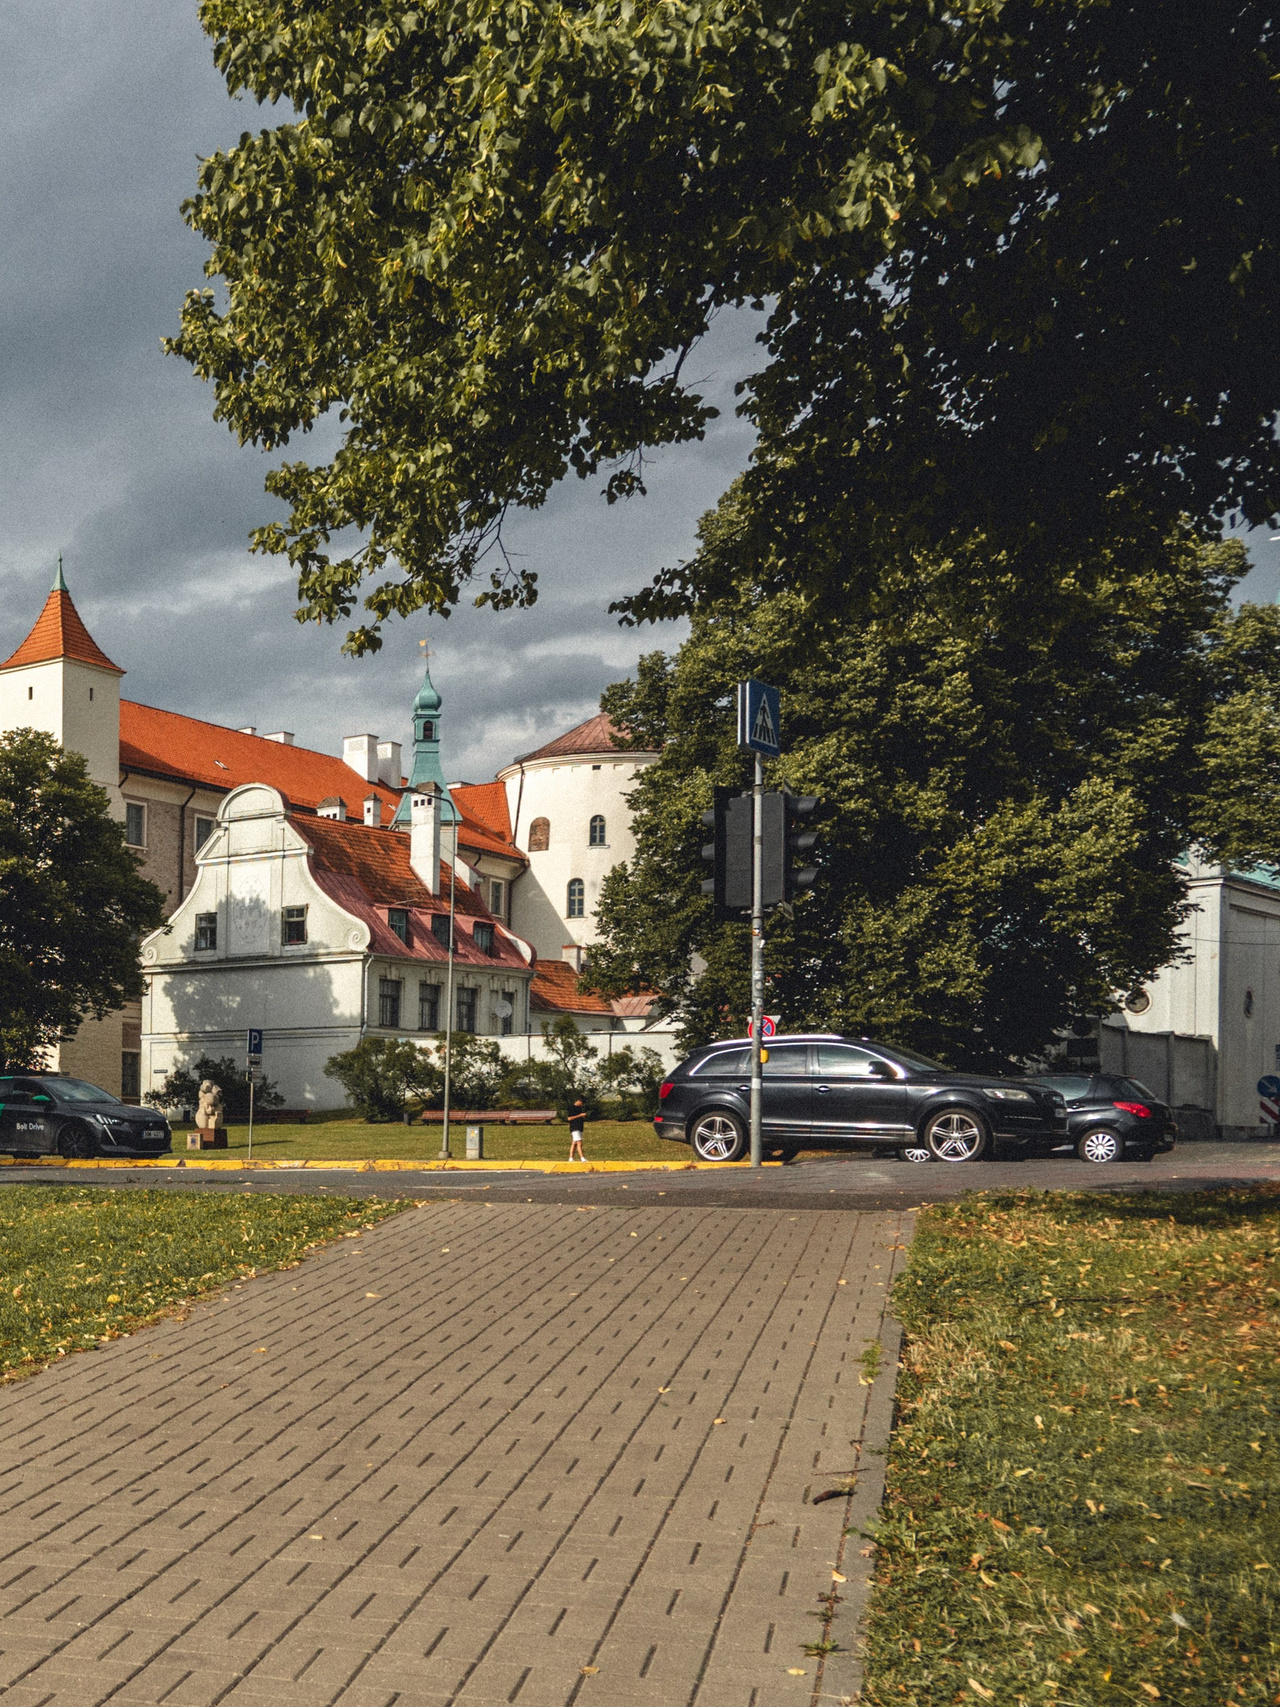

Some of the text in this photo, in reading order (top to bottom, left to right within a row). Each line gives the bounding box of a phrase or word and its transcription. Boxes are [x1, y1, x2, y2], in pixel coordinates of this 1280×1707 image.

[251, 1031, 260, 1051] P
[16, 1122, 45, 1130] Bolt Drive
